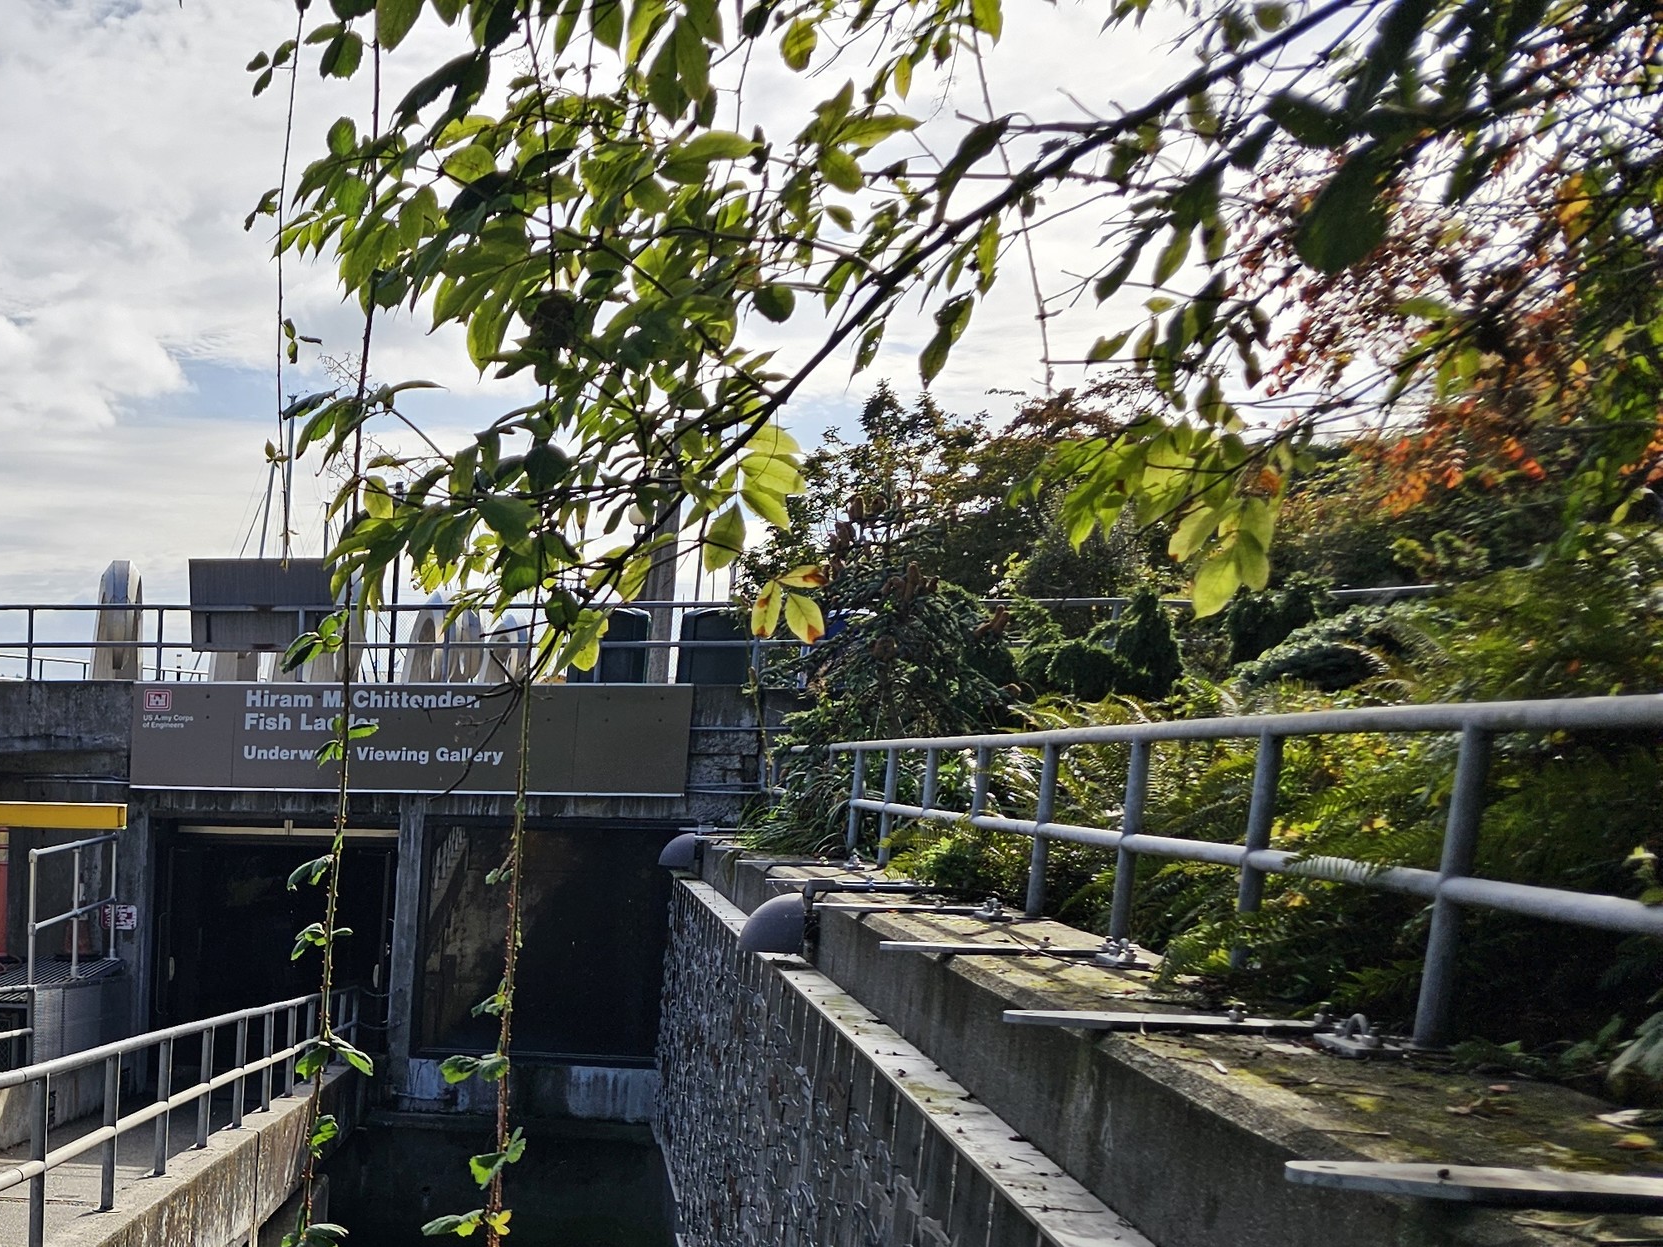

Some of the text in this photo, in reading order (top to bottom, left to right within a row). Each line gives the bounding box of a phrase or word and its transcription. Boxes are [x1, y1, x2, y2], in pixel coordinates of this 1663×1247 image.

[245, 689, 480, 709] Hiram M. Chittenden
[151, 721, 184, 729] Engineers
[154, 714, 172, 722] Army
[173, 714, 194, 722] Corps
[244, 712, 292, 731] Fish
[356, 746, 430, 765] Viewing
[435, 746, 504, 766] Gallery
